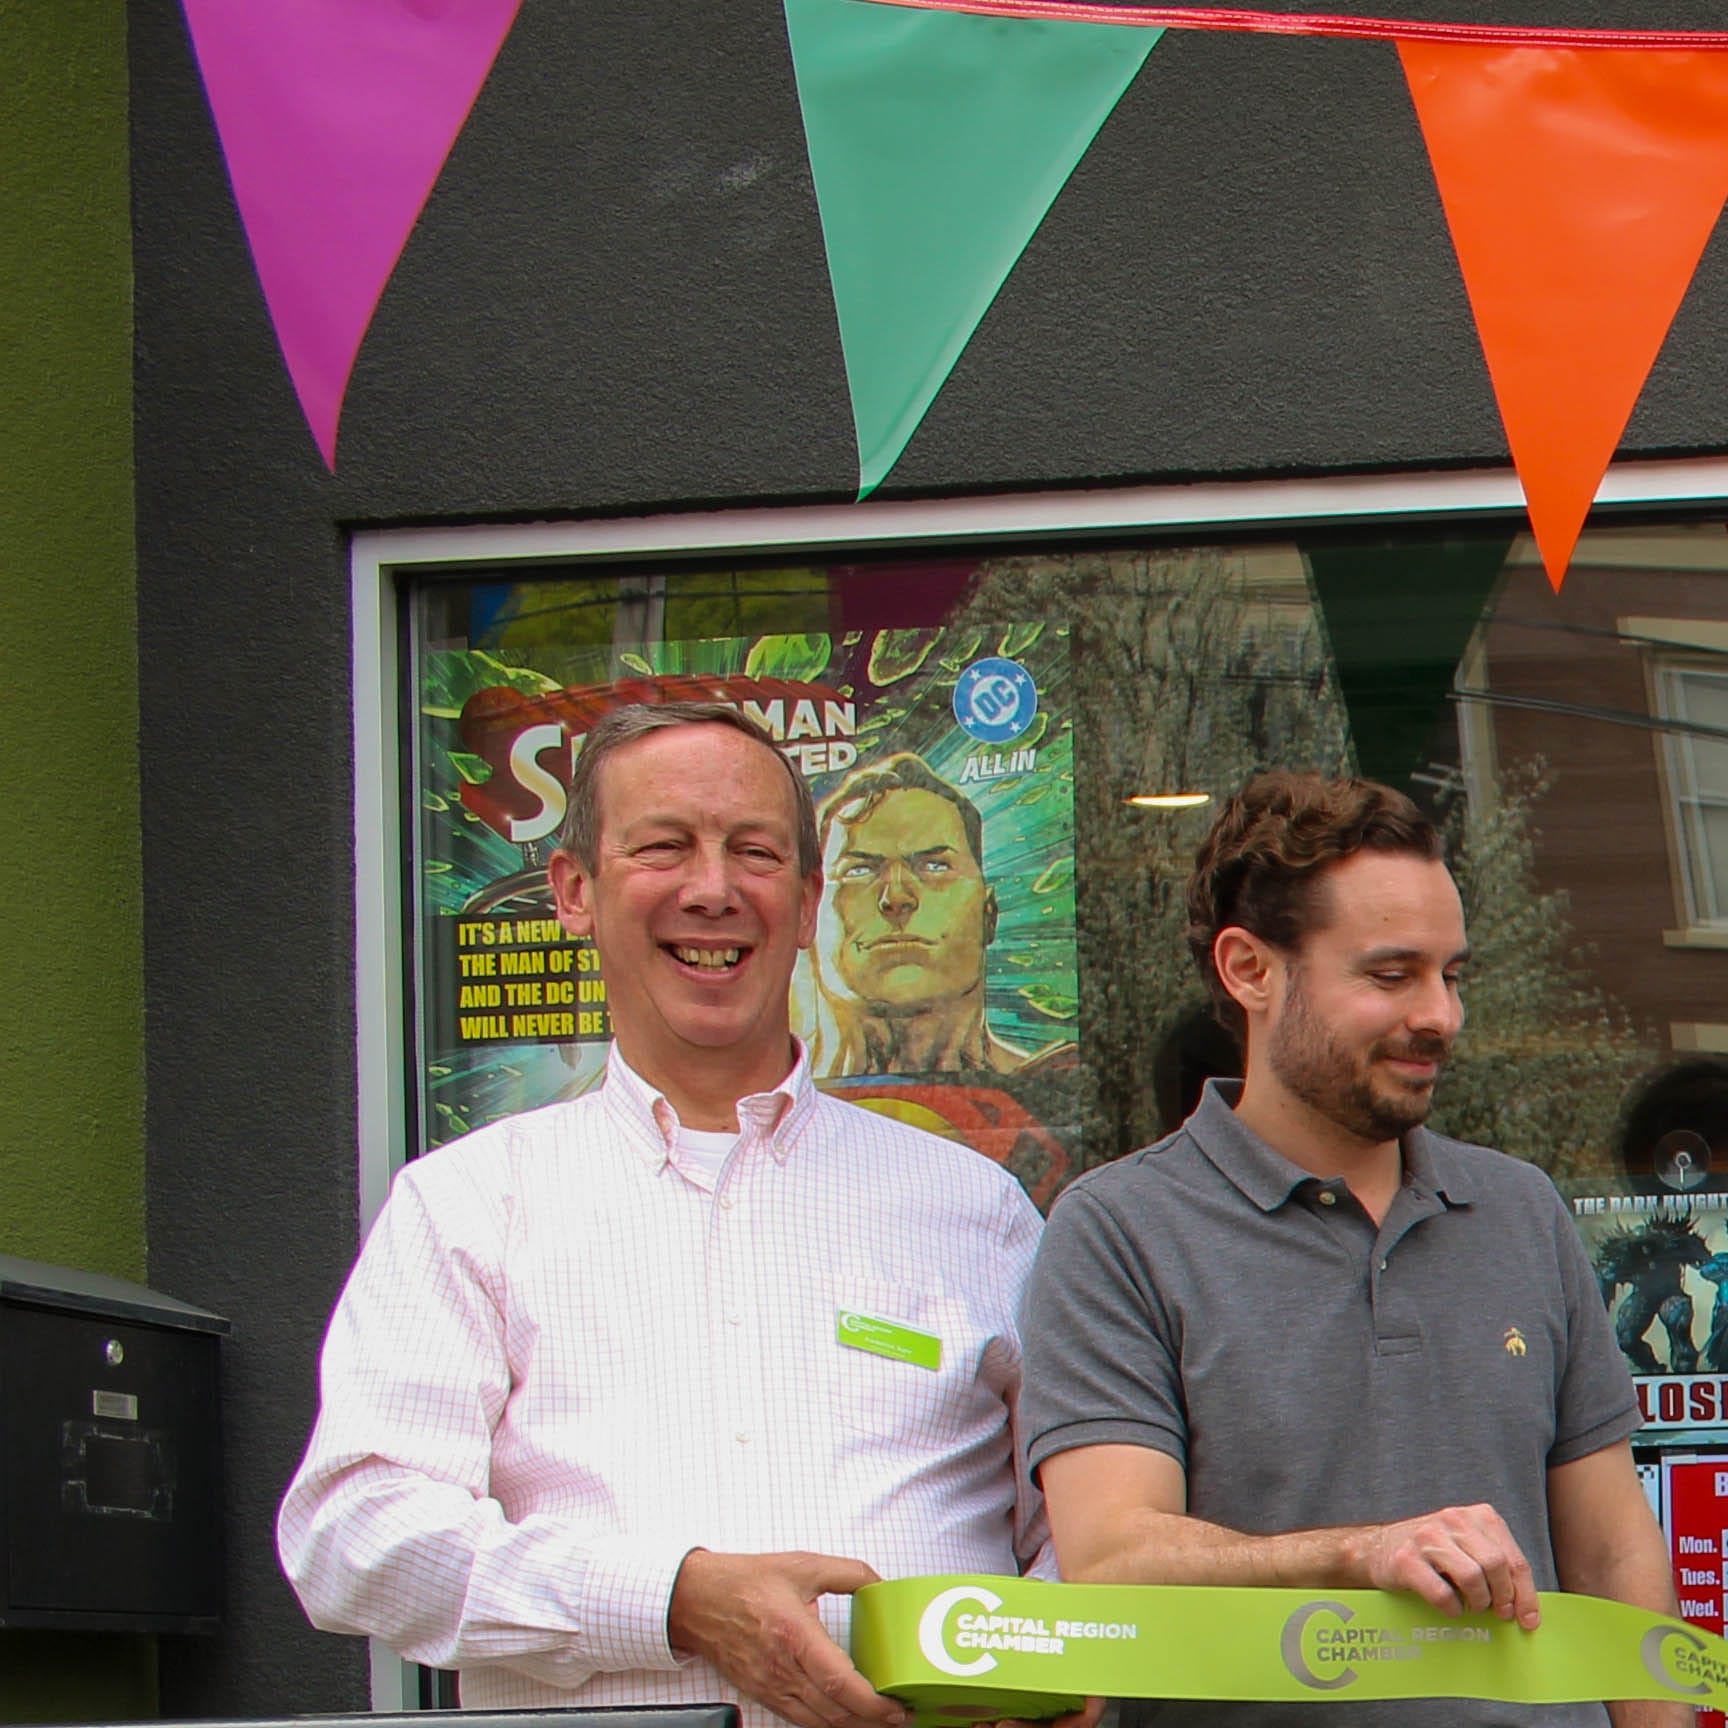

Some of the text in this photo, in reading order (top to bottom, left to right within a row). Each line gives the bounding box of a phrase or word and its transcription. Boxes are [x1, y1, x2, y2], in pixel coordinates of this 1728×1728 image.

[974, 680, 1016, 720] DC
[960, 749, 1036, 783] ALL IN
[459, 922, 496, 946] IT'S
[499, 921, 513, 944] A
[517, 920, 561, 943] NEW
[459, 953, 496, 977] THE
[501, 951, 544, 975] MAN
[549, 950, 574, 973] OF
[460, 985, 501, 1008] AND
[505, 983, 542, 1006] THE
[546, 981, 574, 1004] DC
[460, 1015, 508, 1039] WILL
[512, 1013, 574, 1037] NEVER
[579, 1012, 603, 1034] BE
[1573, 1197, 1606, 1216] THE
[1610, 1195, 1658, 1214] DARK
[1679, 1536, 1718, 1554] Mon.
[1680, 1568, 1720, 1586] Tues.
[1680, 1599, 1719, 1617] Wed.
[956, 1613, 1137, 1640] CAPITAL REGION
[1316, 1626, 1492, 1646] CAPITAL REGION
[956, 1631, 1065, 1656] CHAMBER
[1317, 1645, 1422, 1662] CHAMBER
